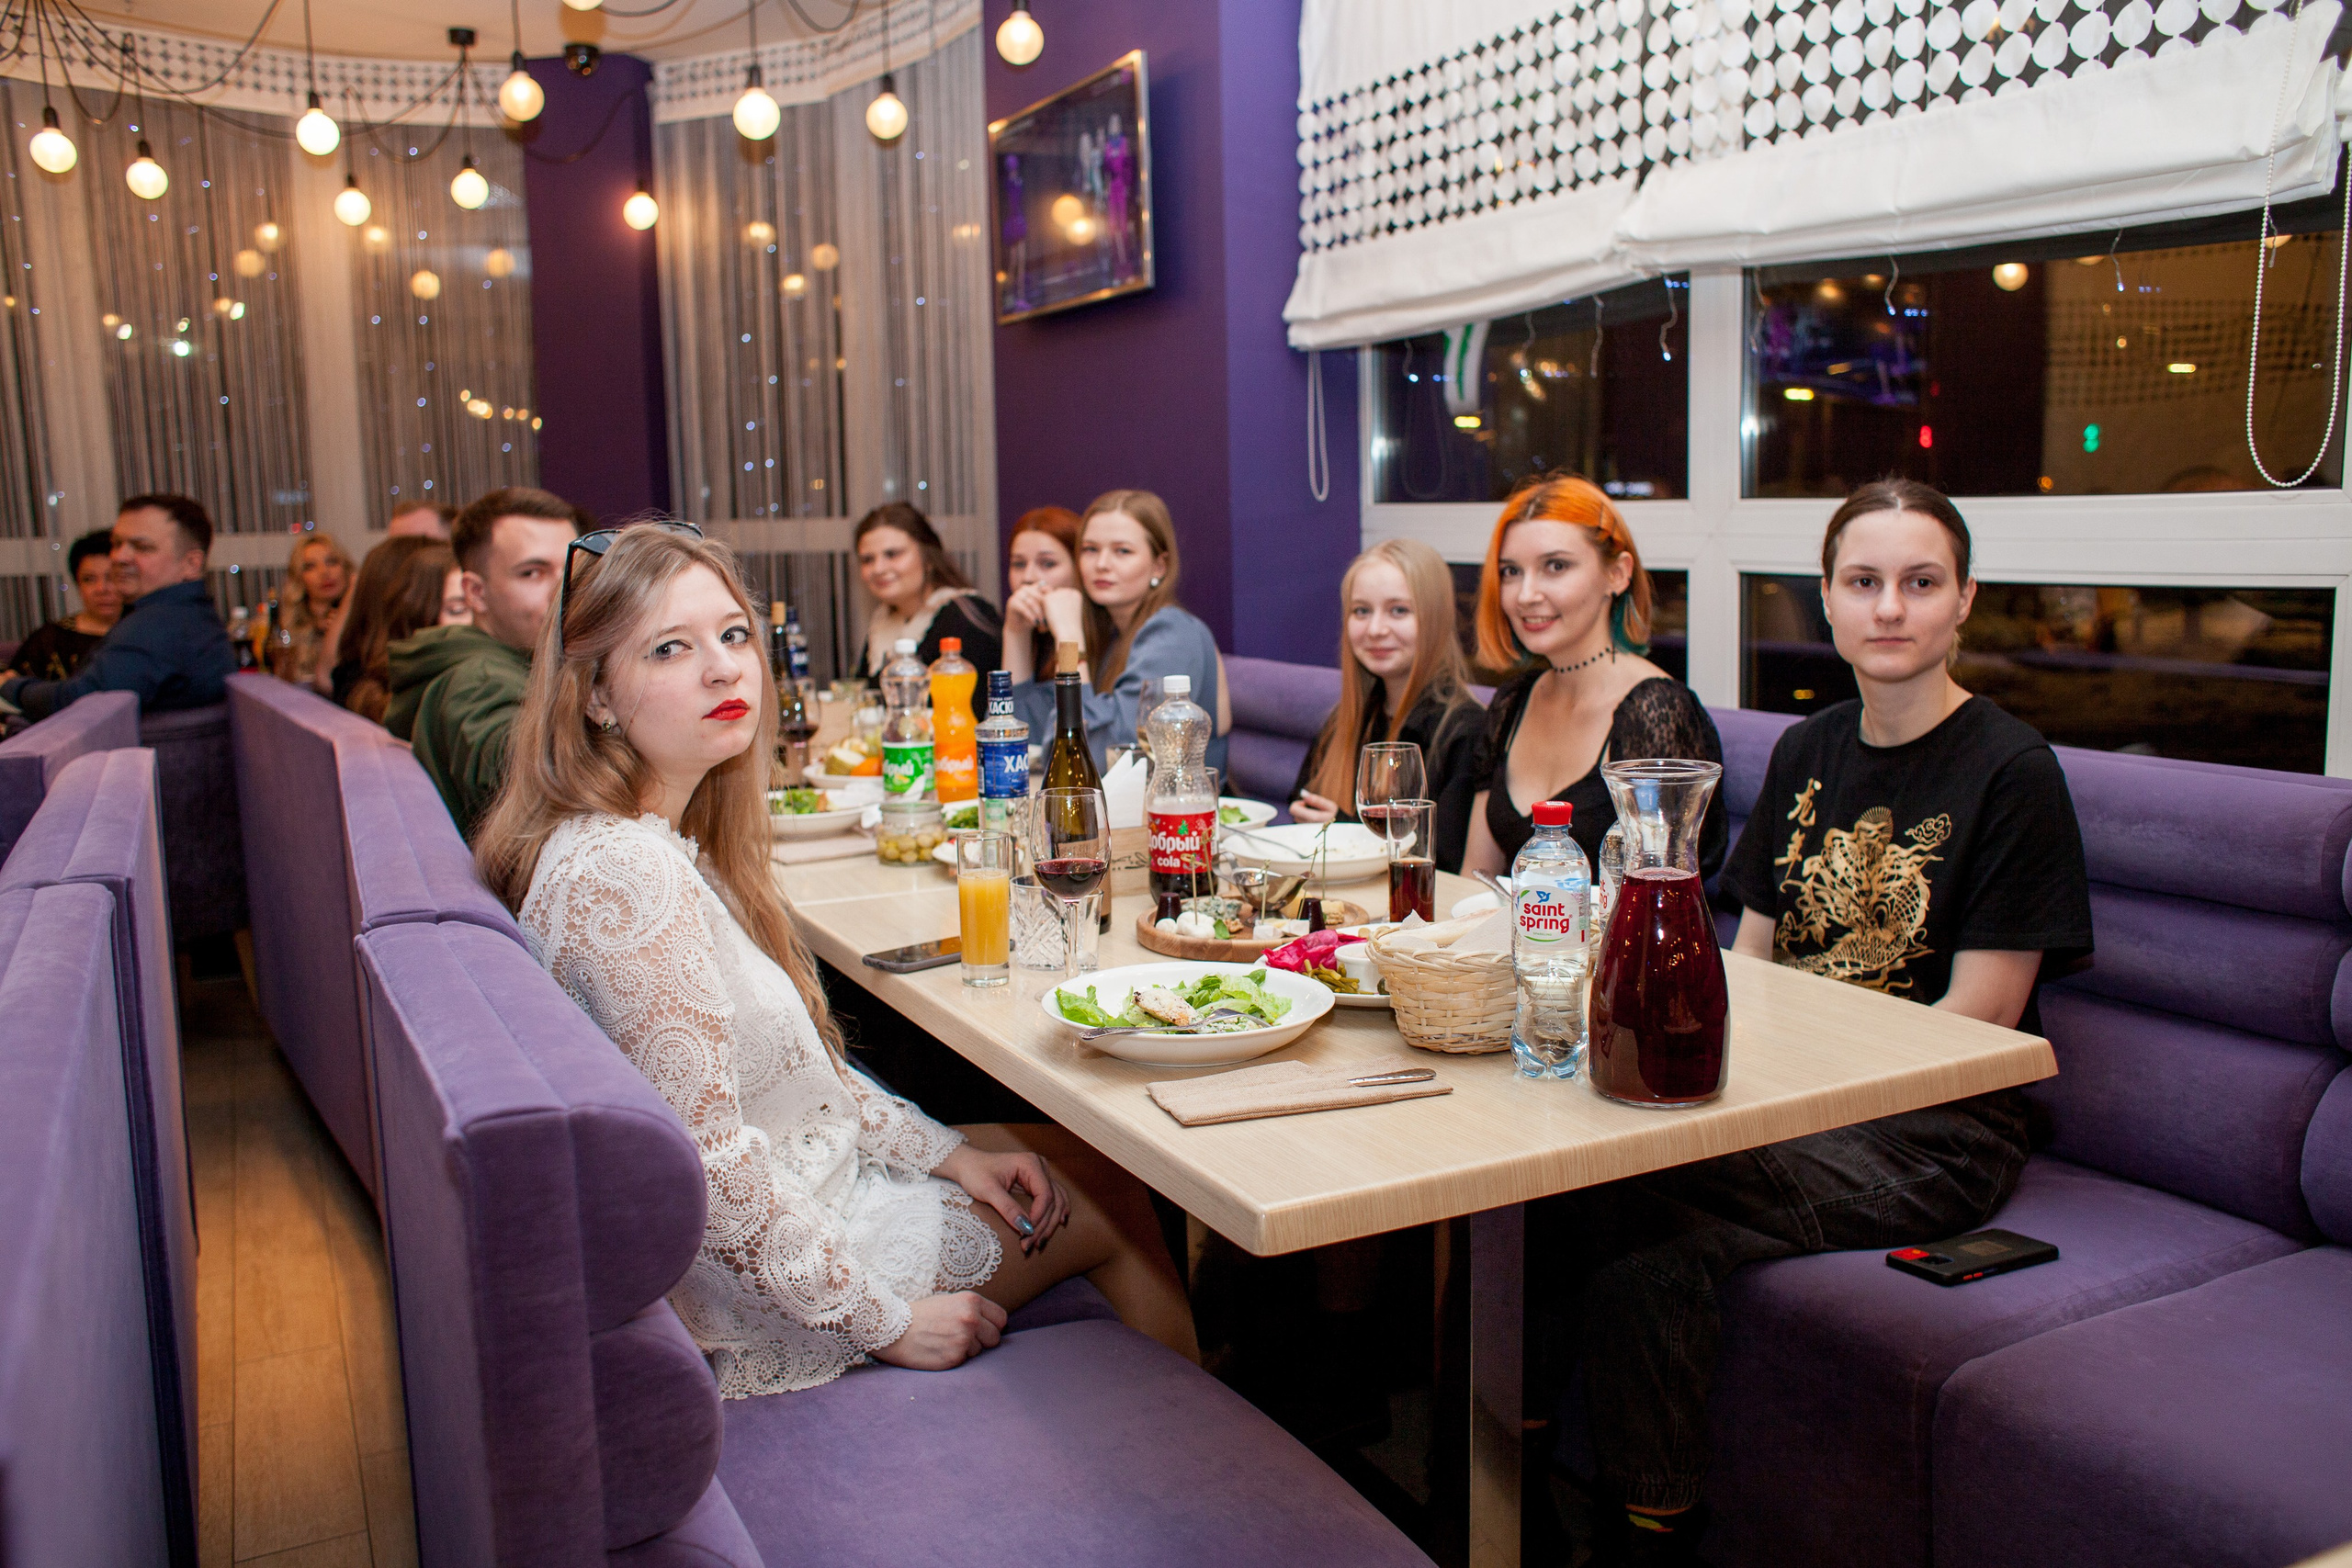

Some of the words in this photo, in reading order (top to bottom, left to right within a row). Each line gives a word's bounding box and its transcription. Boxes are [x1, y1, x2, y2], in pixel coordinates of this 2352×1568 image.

[1148, 830, 1201, 854] обрый
[1157, 856, 1181, 868] cola
[1523, 903, 1565, 917] saint
[1520, 915, 1569, 934] spring
